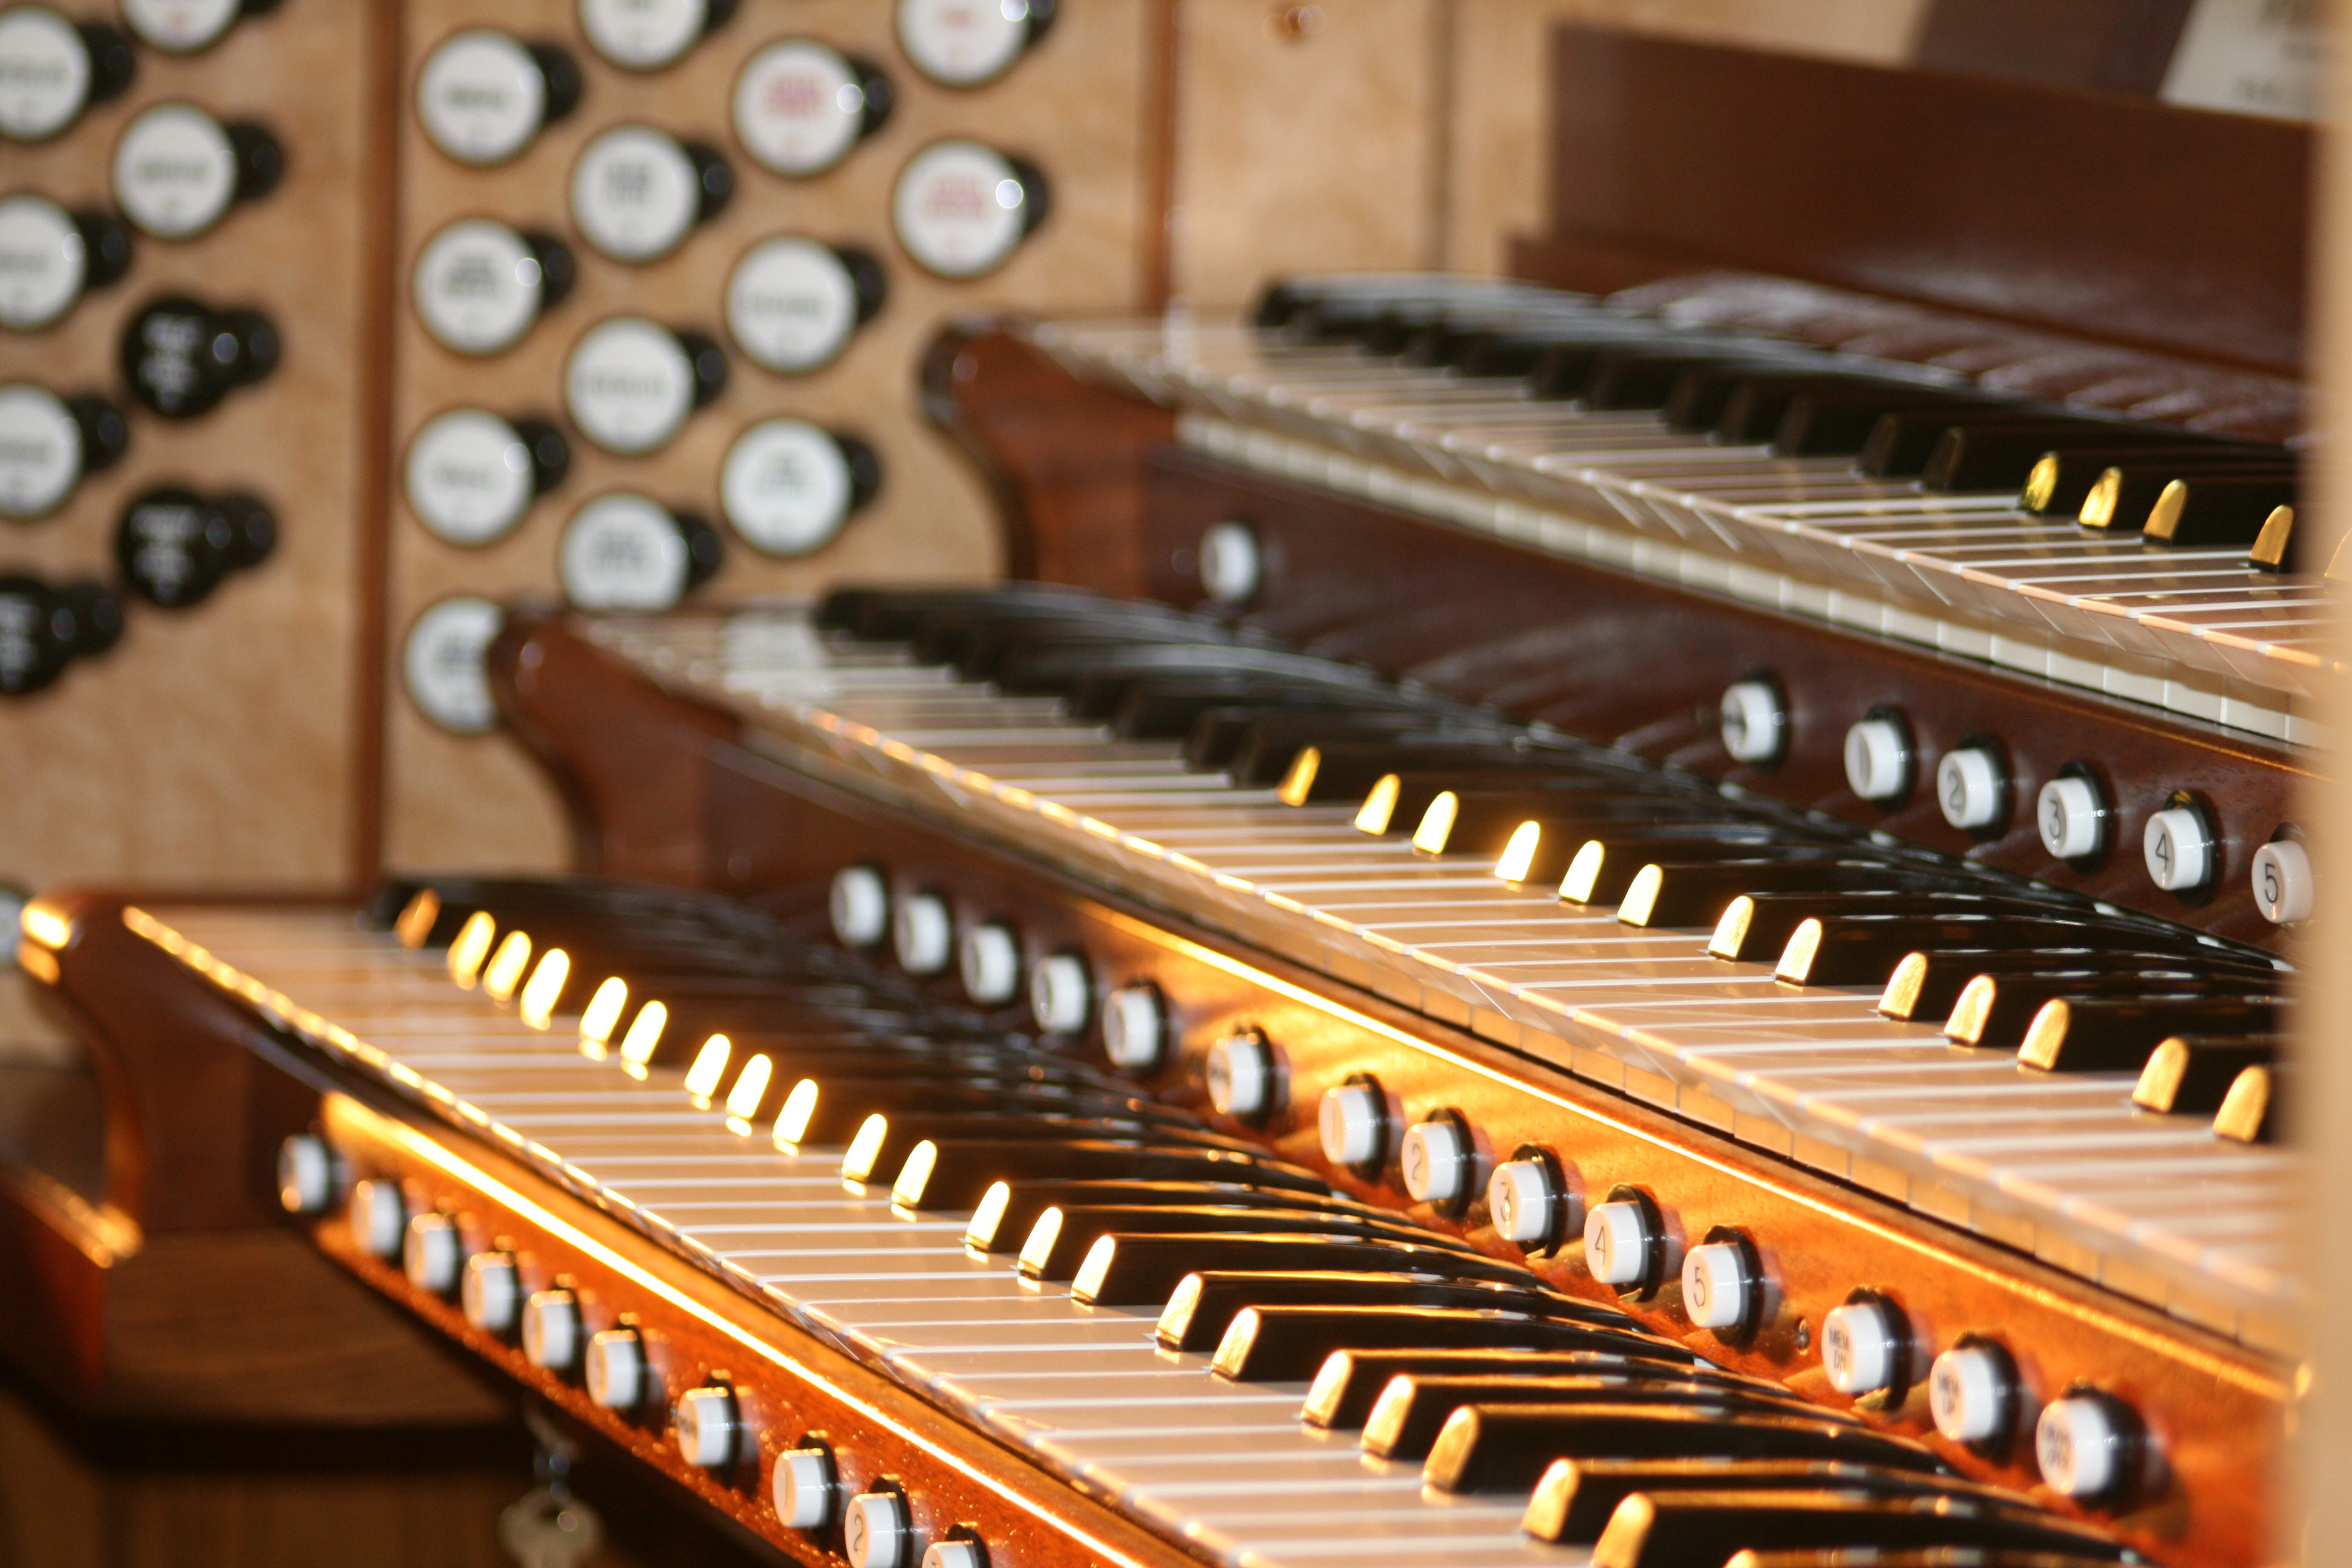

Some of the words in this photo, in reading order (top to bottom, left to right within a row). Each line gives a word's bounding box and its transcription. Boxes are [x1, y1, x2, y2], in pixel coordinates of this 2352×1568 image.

[1947, 769, 1962, 810] 2
[2048, 798, 2061, 838] 3
[2155, 832, 2169, 872] 4
[2264, 863, 2279, 903] 5
[1412, 1143, 1422, 1181] 2
[1499, 1181, 1512, 1222] 3
[1595, 1226, 1607, 1265] 4
[1694, 1266, 1706, 1307] 5
[1829, 1326, 1849, 1351] MEM
[854, 1514, 863, 1555] 2
